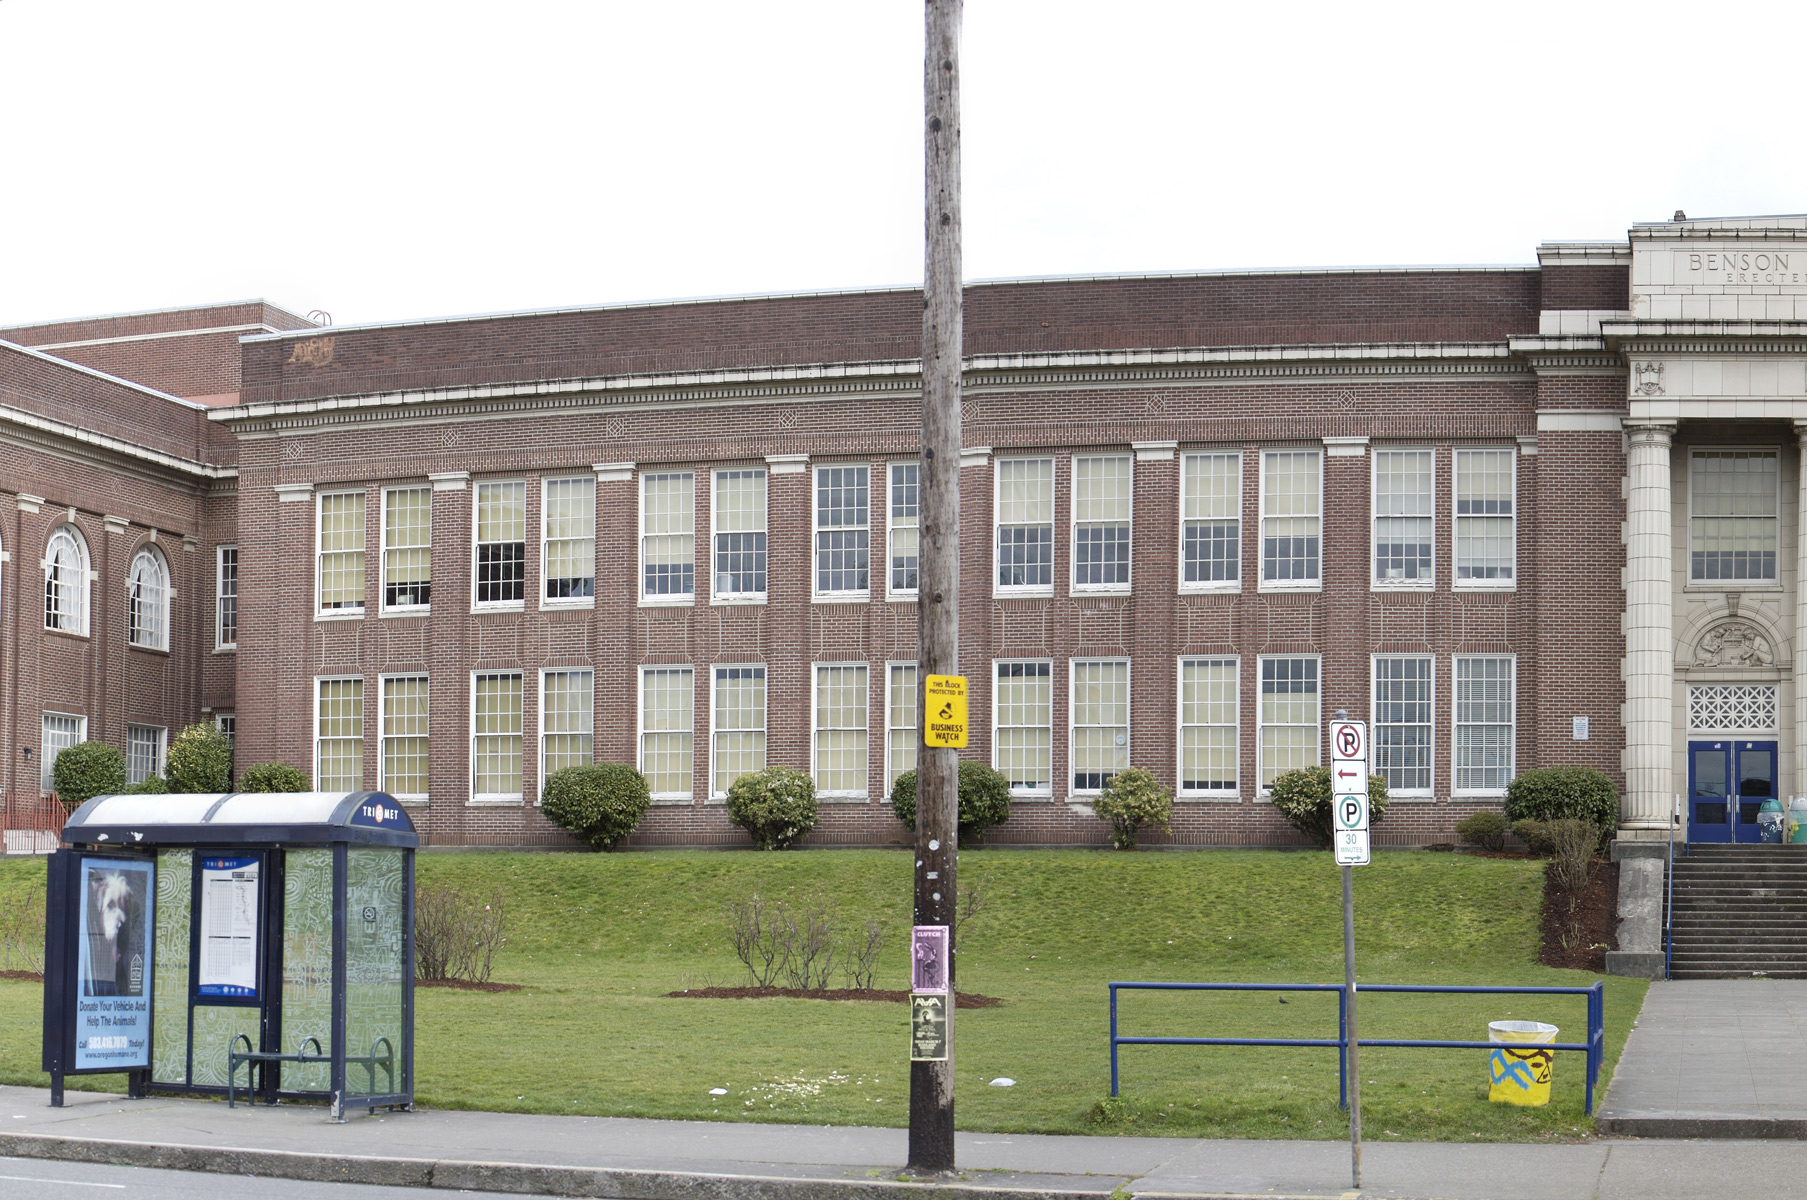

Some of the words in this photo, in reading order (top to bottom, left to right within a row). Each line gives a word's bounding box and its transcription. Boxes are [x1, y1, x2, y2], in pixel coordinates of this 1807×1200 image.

[1688, 254, 1790, 272] BENSON
[929, 688, 956, 696] PROTECTED
[931, 723, 963, 733] BUSINESS
[935, 732, 960, 741] WATCH
[1345, 833, 1357, 845] 30
[79, 1000, 98, 1012] Donate
[99, 1000, 112, 1012] Your
[112, 1000, 134, 1012] Vehicle
[135, 1000, 146, 1012] And
[87, 1015, 100, 1029] Help
[101, 1015, 112, 1026] The
[112, 1015, 137, 1026] Animals!
[129, 1039, 145, 1049] Today!
